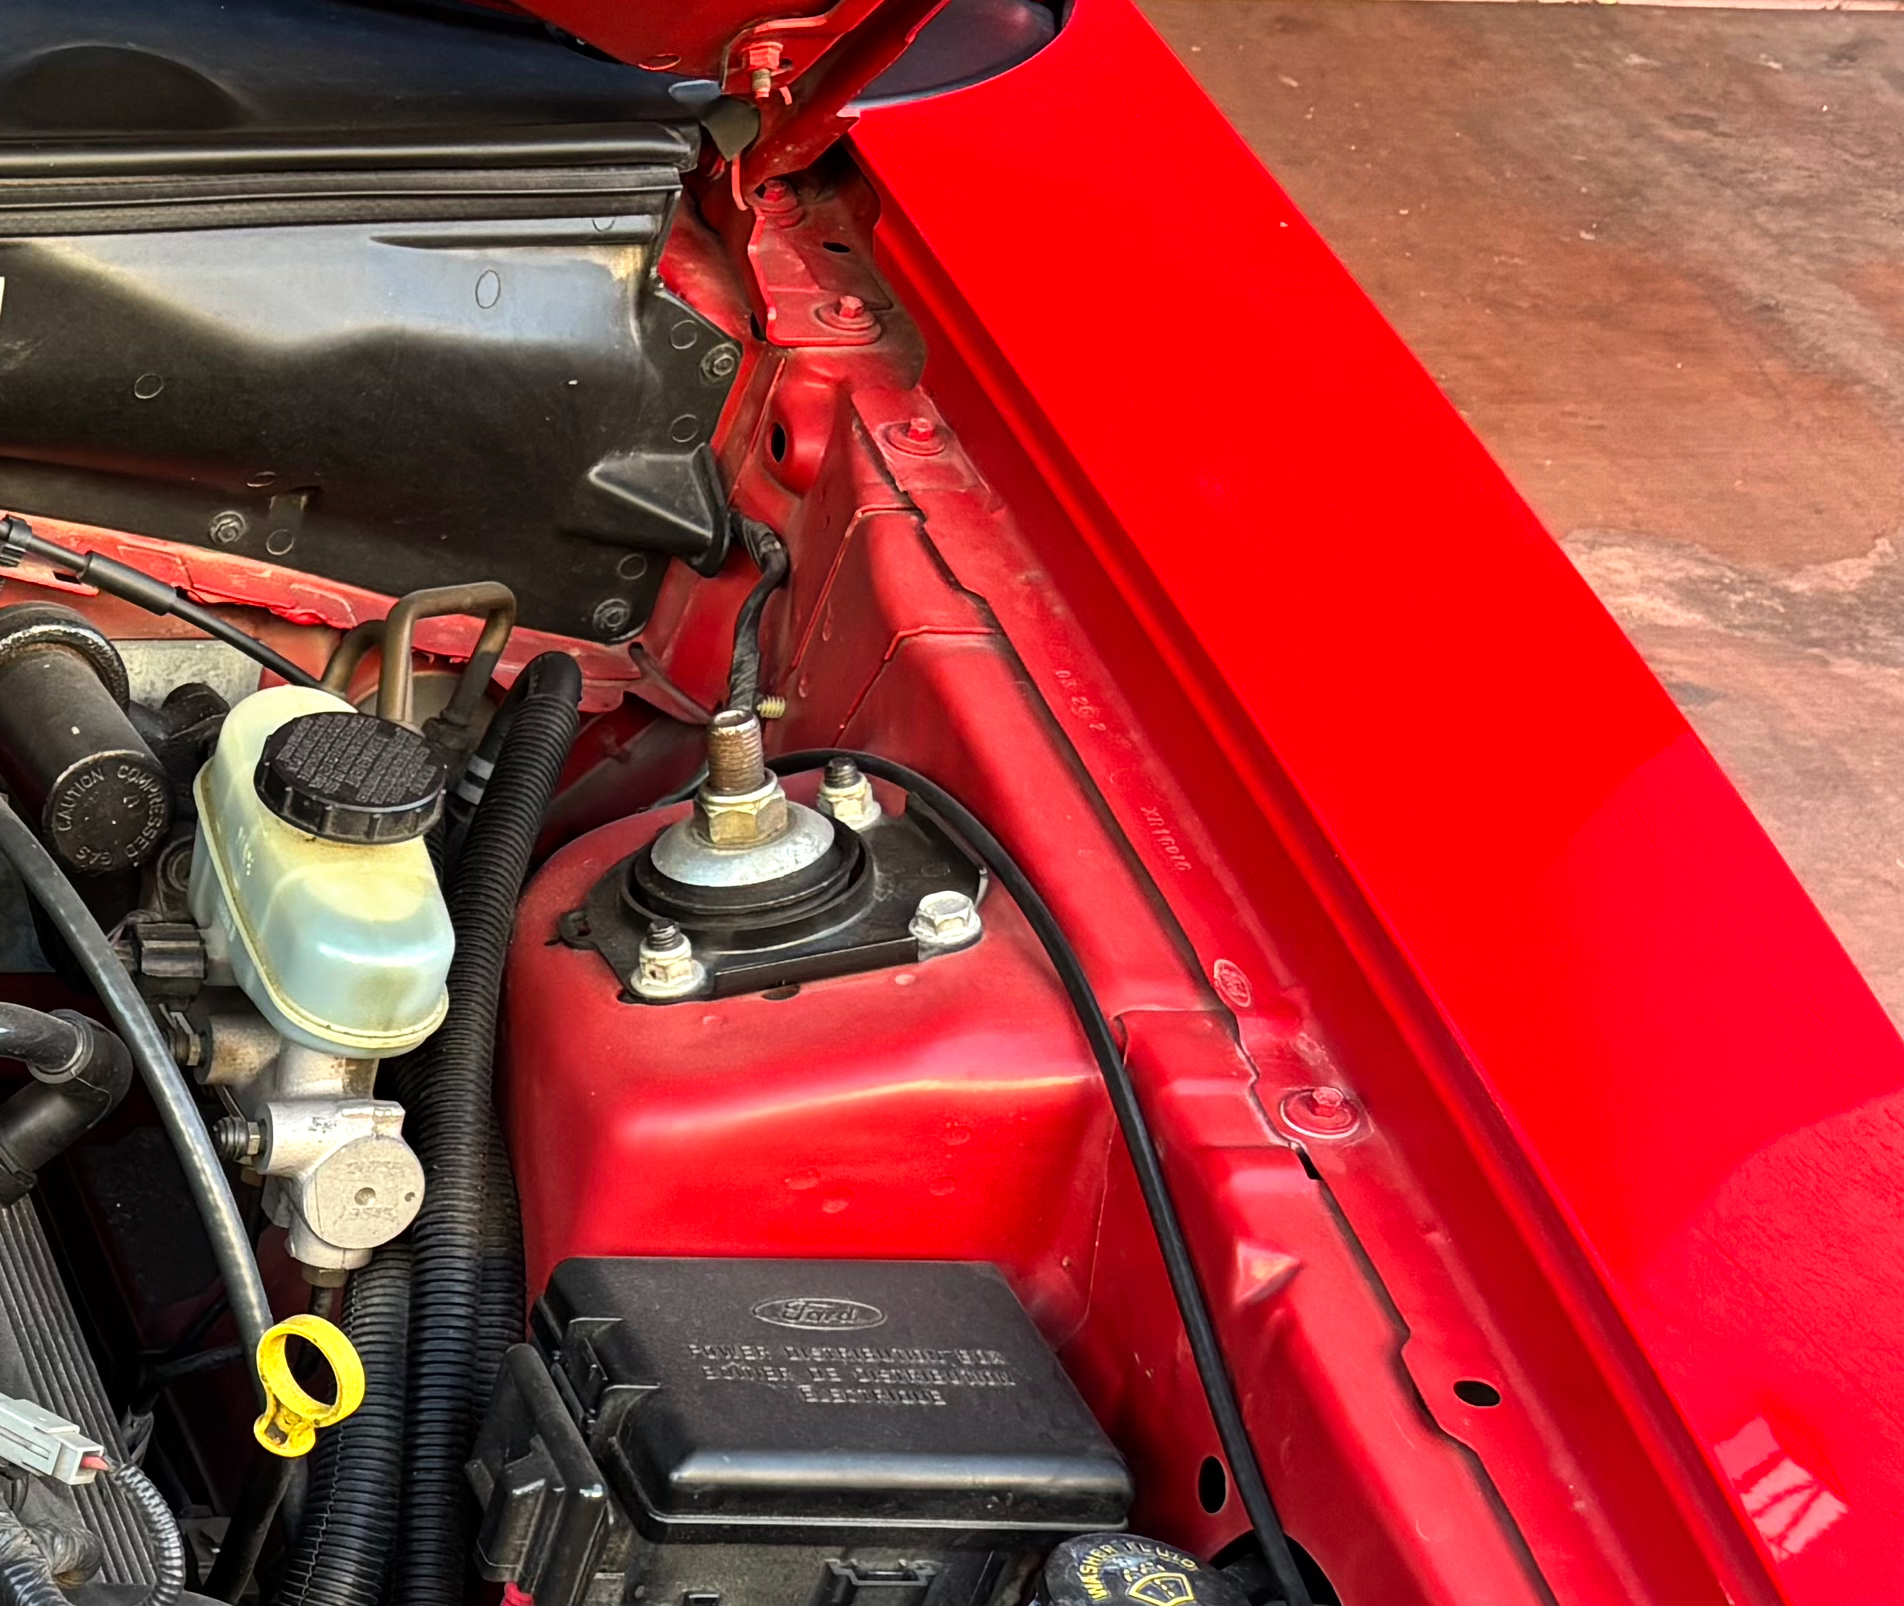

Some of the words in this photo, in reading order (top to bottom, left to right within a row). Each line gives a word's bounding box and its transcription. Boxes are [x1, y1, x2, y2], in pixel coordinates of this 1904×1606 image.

[57, 767, 106, 833] CAUTION
[116, 765, 166, 861] COMPRESSED
[75, 845, 113, 867] GAS
[780, 1300, 856, 1324] Ford
[689, 1344, 773, 1362] POWER
[785, 1346, 947, 1364] DISTRIBUTION
[956, 1348, 1010, 1366] BOX
[809, 1366, 843, 1382] DE
[1078, 1544, 1119, 1602] WASHER
[1126, 1541, 1199, 1572] FLUID
